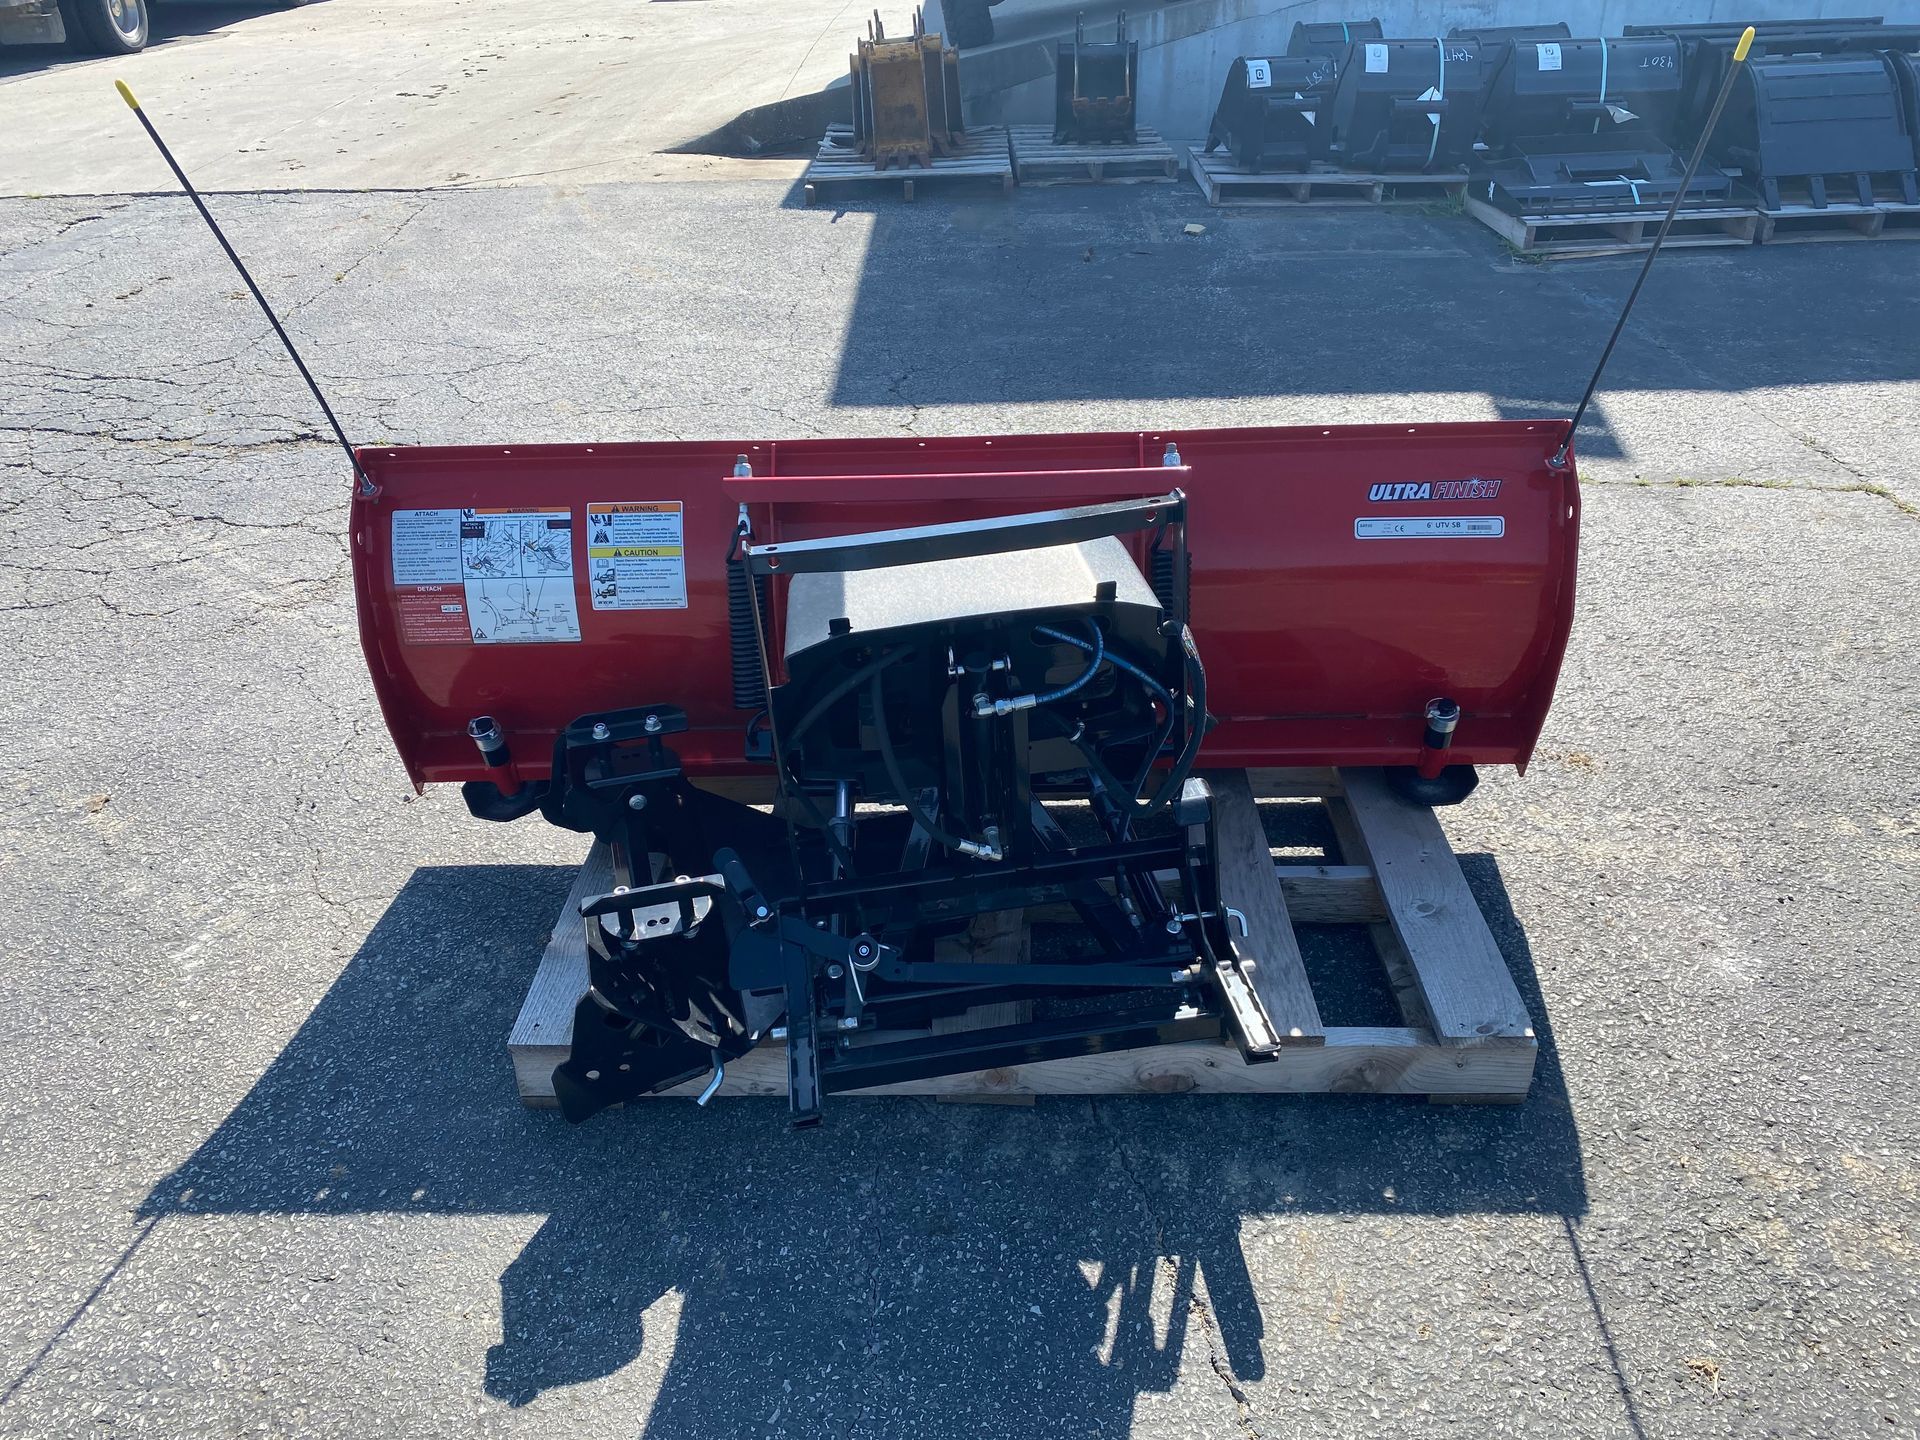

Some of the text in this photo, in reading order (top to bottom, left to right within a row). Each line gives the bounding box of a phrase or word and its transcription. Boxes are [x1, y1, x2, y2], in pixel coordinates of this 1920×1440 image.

[1639, 55, 1674, 69] 430T
[1369, 479, 1502, 501] ULTRA FINISH
[624, 549, 658, 557] CAUTION
